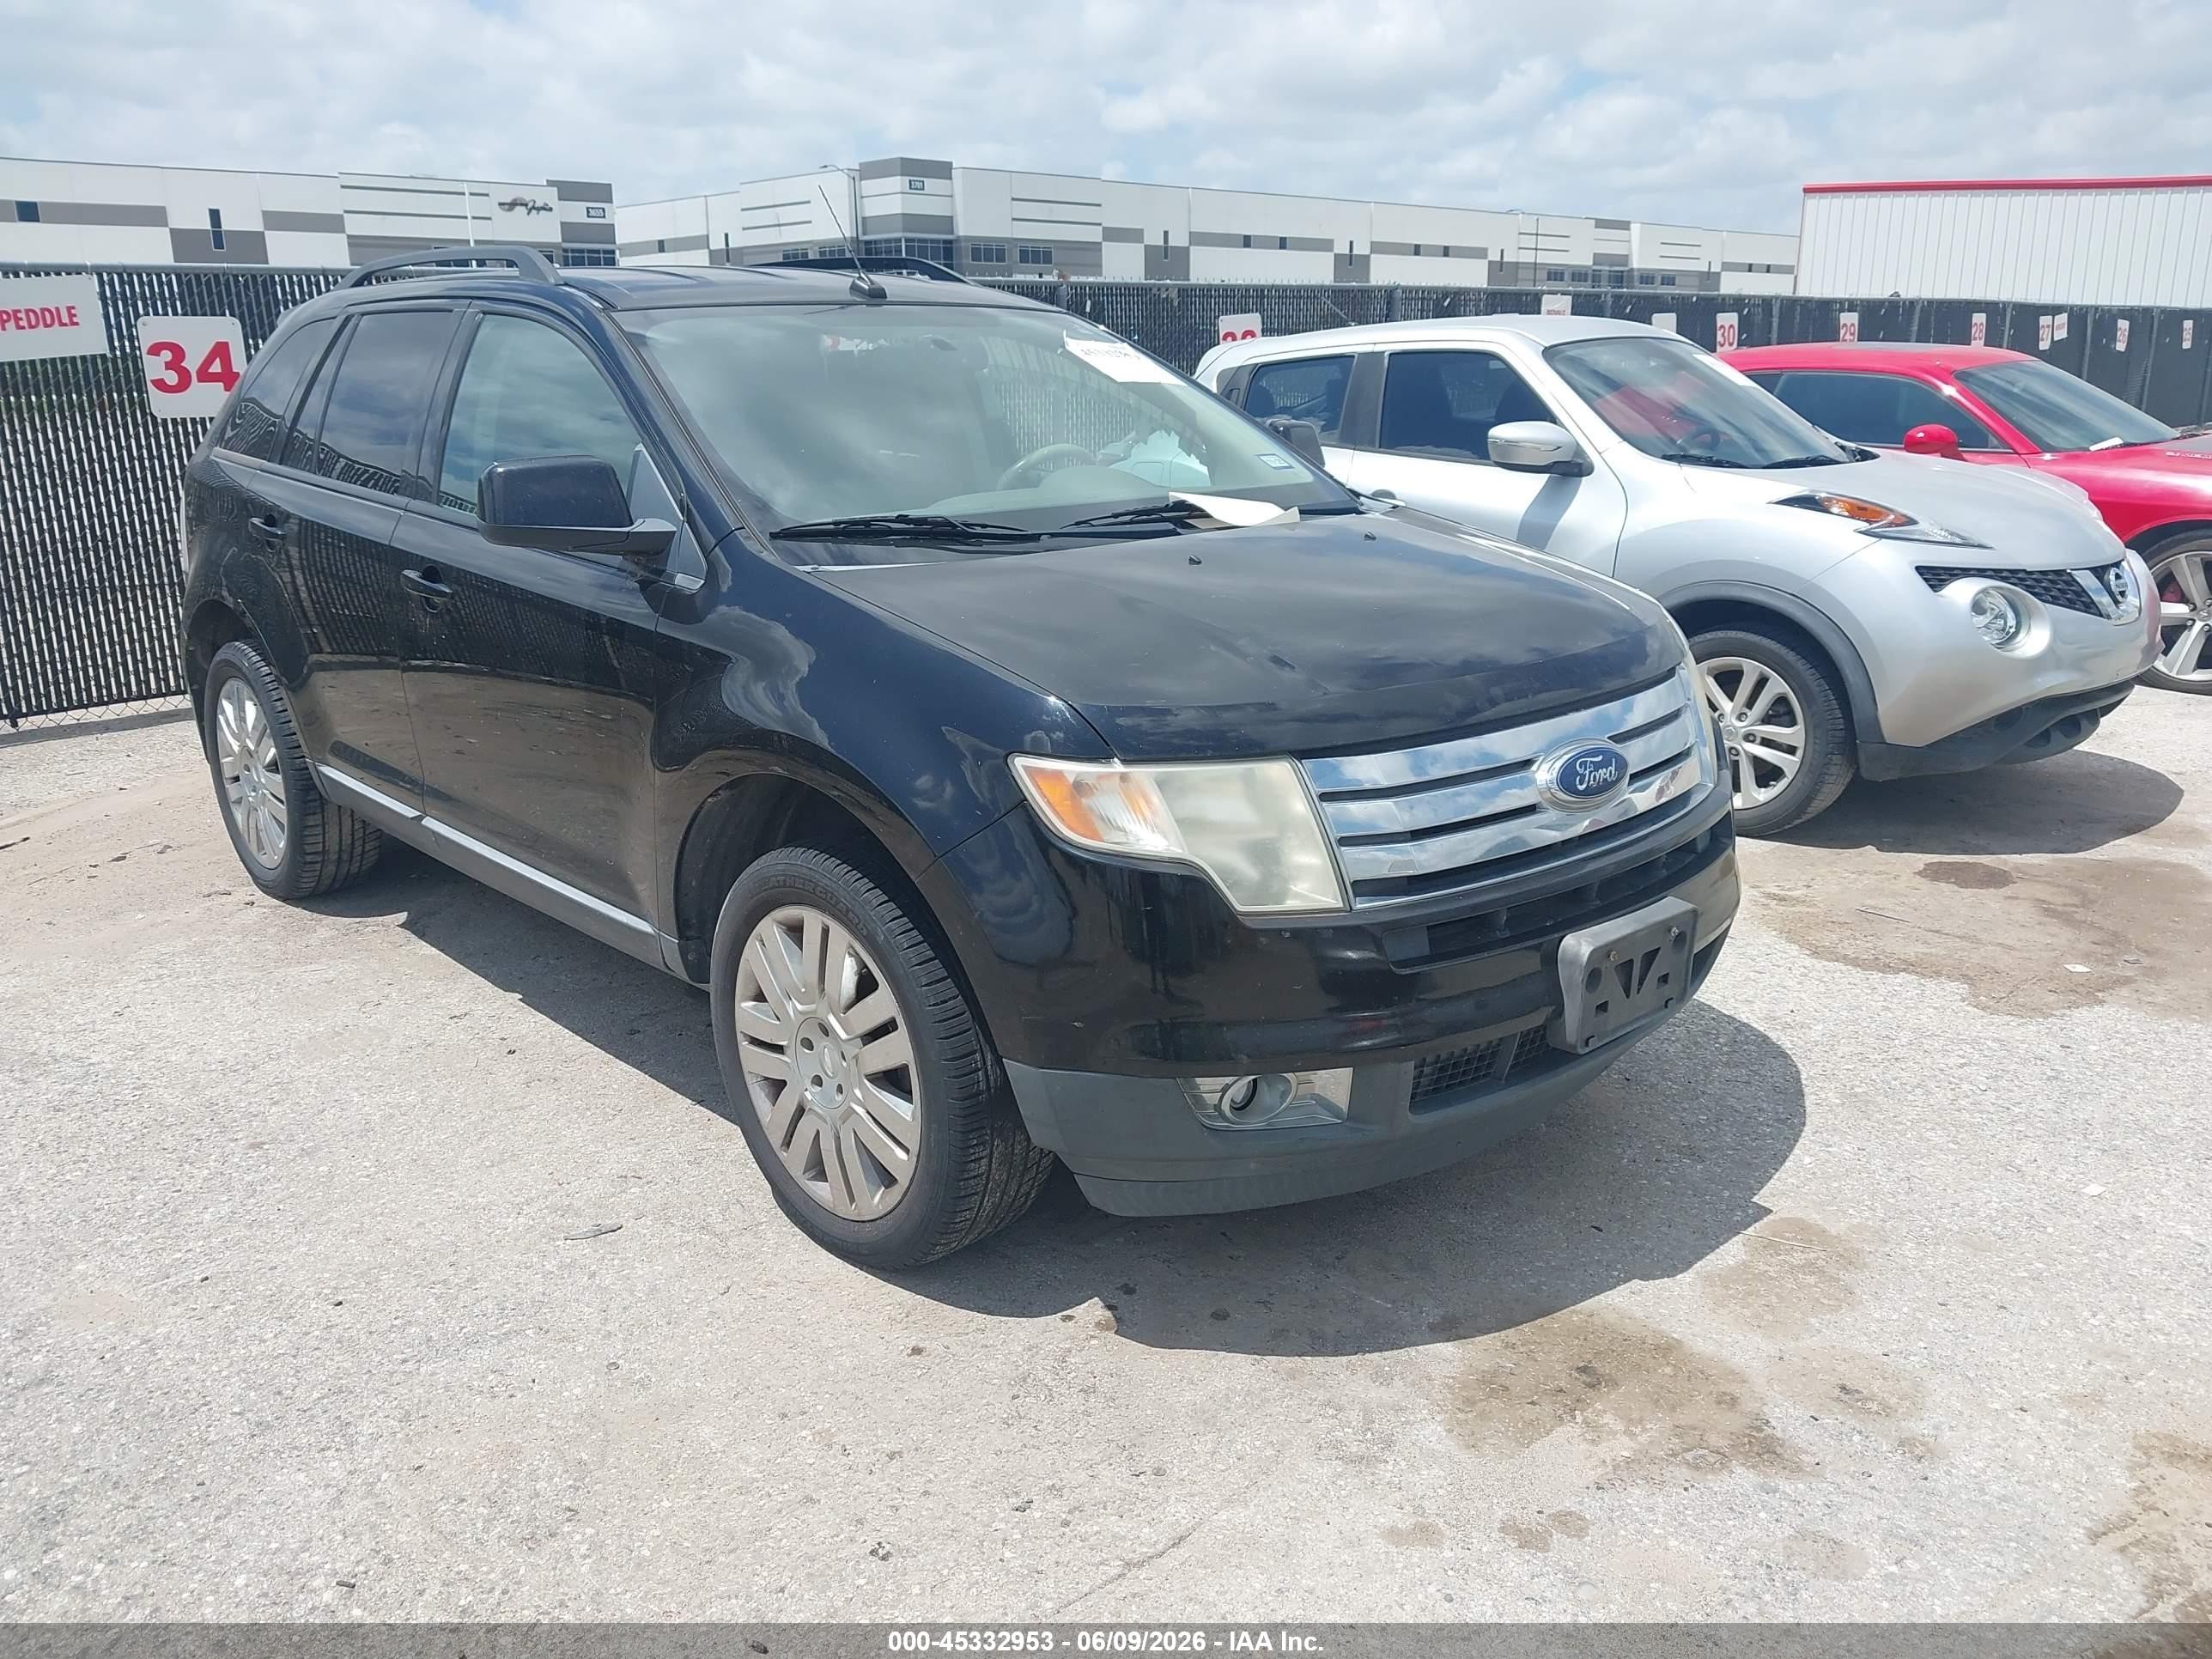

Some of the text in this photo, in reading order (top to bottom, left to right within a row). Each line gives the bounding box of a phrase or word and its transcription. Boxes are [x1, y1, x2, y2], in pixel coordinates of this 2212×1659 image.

[0, 305, 80, 331] PEDDLE
[1717, 324, 1735, 348] 30
[1840, 323, 1856, 342] 29
[1972, 322, 1984, 341] 28
[2040, 324, 2051, 342] 27
[2118, 327, 2127, 344] 26
[146, 340, 240, 394] 34
[1576, 754, 1619, 791] Ford
